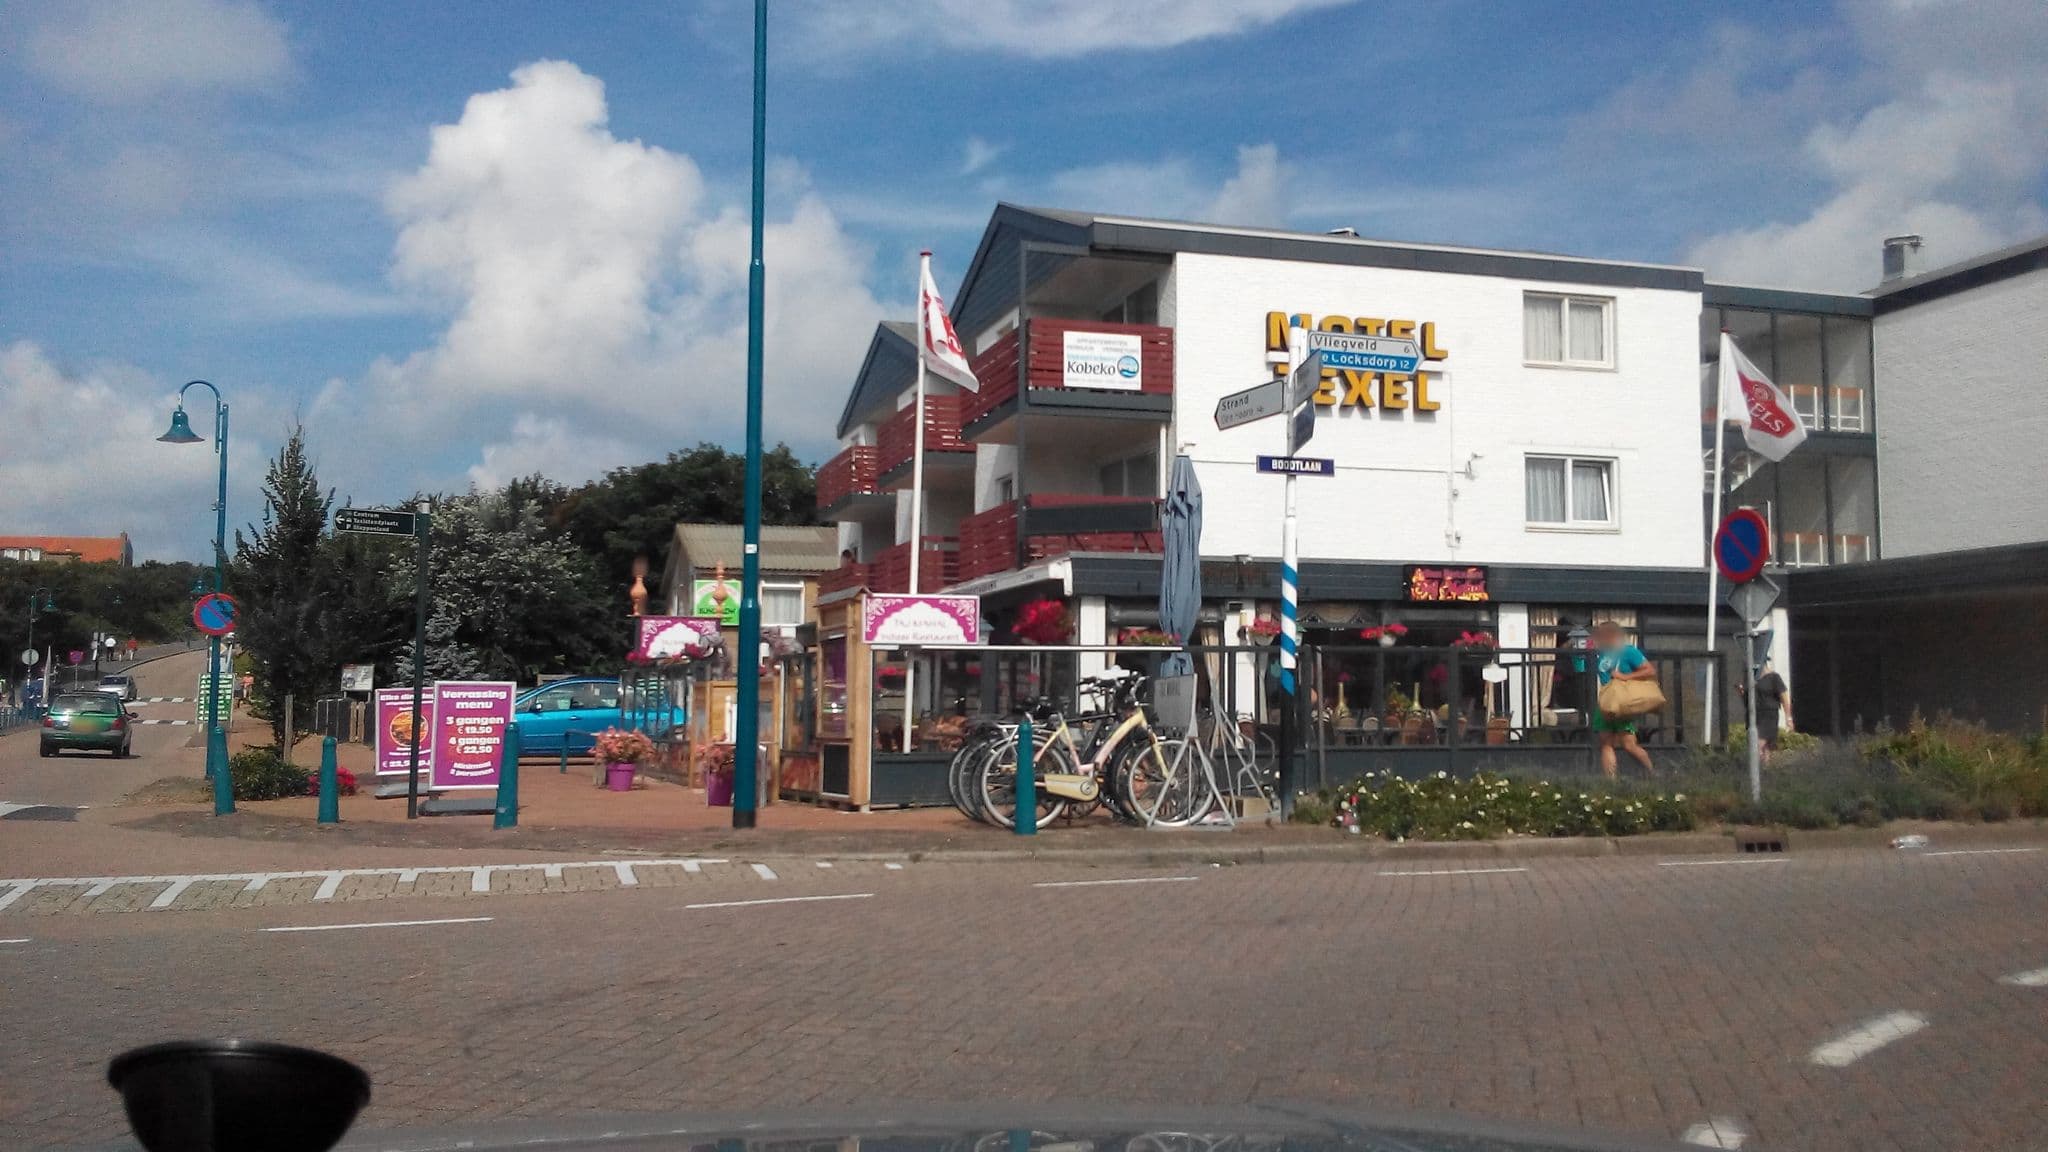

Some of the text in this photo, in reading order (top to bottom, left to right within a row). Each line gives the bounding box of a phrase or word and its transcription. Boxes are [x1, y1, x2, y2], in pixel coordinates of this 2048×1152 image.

[1314, 335, 1411, 354] Vliegveld 6
[1067, 361, 1116, 376] Kobeko
[1400, 359, 1410, 369] 12
[1274, 362, 1441, 411] EXEL
[1221, 394, 1249, 411] Strand
[1271, 459, 1322, 472] BOODTLAAN
[442, 690, 507, 700] Verrassing
[456, 701, 493, 709] menu
[456, 717, 504, 726] gangen
[457, 726, 464, 734] €
[449, 736, 500, 746] 4 gangen
[456, 745, 462, 754] €
[453, 761, 491, 770] Minimaal
[456, 768, 494, 777] personen
